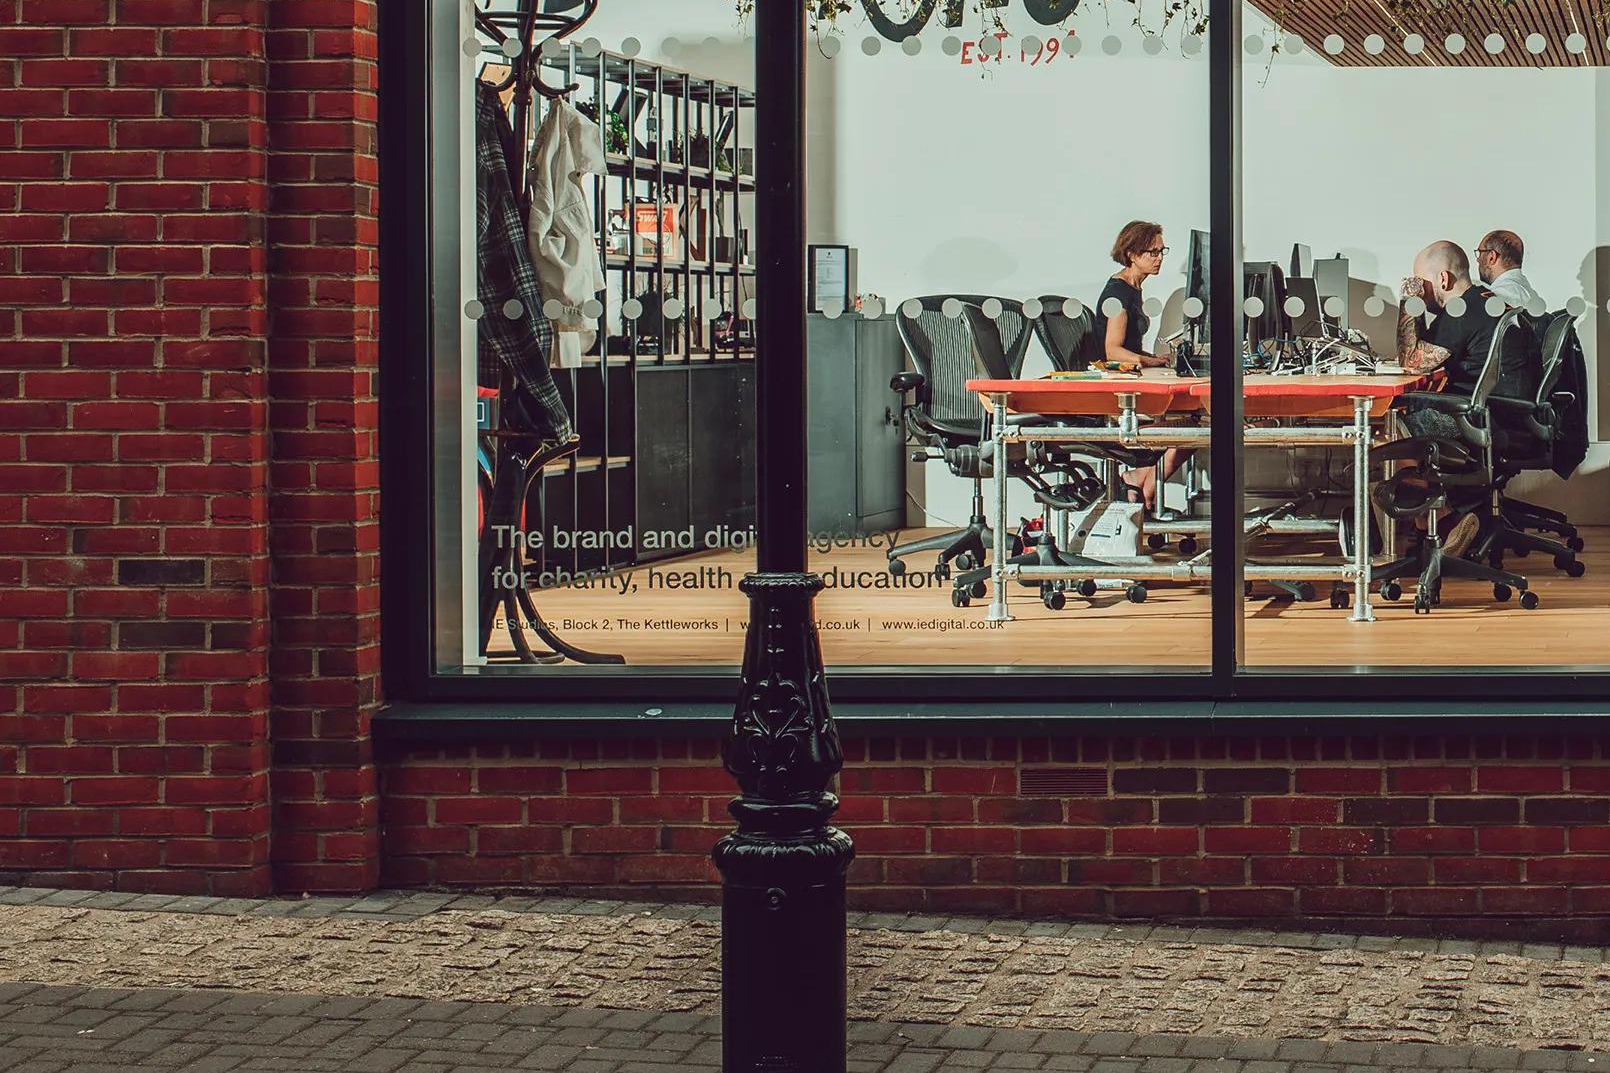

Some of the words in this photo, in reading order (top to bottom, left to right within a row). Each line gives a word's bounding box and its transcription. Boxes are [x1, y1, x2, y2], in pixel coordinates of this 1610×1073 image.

[491, 525, 544, 549] The
[553, 525, 633, 549] brand
[643, 525, 695, 549] and
[704, 525, 758, 554] digi
[491, 565, 530, 589] for
[538, 565, 638, 595] charity,
[648, 565, 732, 589] health
[822, 565, 942, 589] ducation
[507, 618, 559, 632] Sudios,
[563, 618, 599, 630] Block
[602, 618, 613, 632] 2,
[617, 618, 641, 630] The
[644, 618, 719, 630] Kettleworks
[882, 618, 1005, 632] www.iedigital.co.uk
